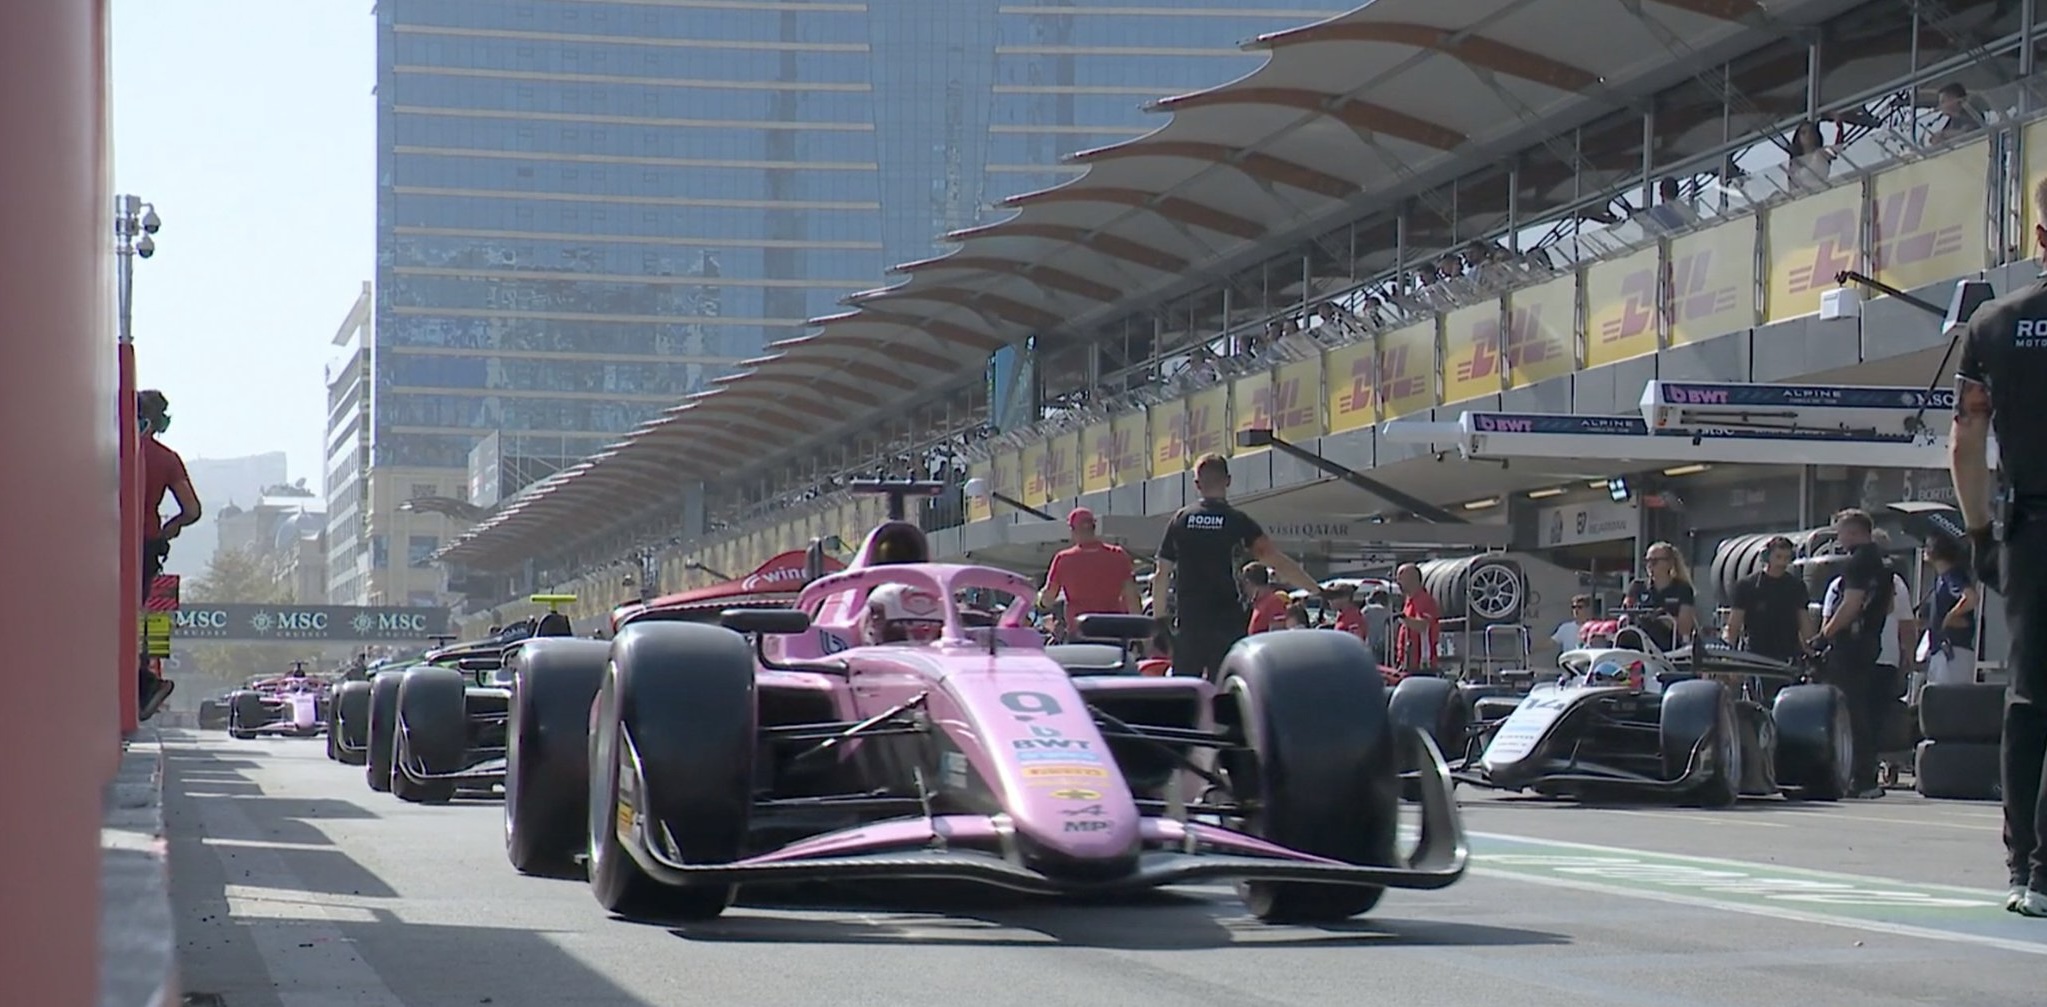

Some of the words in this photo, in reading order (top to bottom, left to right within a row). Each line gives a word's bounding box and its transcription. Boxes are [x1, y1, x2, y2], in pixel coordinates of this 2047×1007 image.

[1811, 185, 1935, 289] DHL
[1621, 250, 1716, 338] DHL
[2017, 320, 2047, 337] RO
[1471, 303, 1546, 379] DHL
[1351, 346, 1412, 411] DHL
[1689, 390, 1728, 403] BWT
[1783, 390, 1841, 398] ALPINE
[1496, 419, 1531, 432] BWT
[1581, 419, 1633, 428] ALPINE
[1187, 514, 1223, 525] RODIN
[175, 611, 227, 629] MSC
[277, 612, 328, 629] MSC
[378, 613, 426, 631] MSC
[1000, 691, 1062, 722] 9
[1525, 699, 1568, 711] 14
[1013, 739, 1090, 749] BWT
